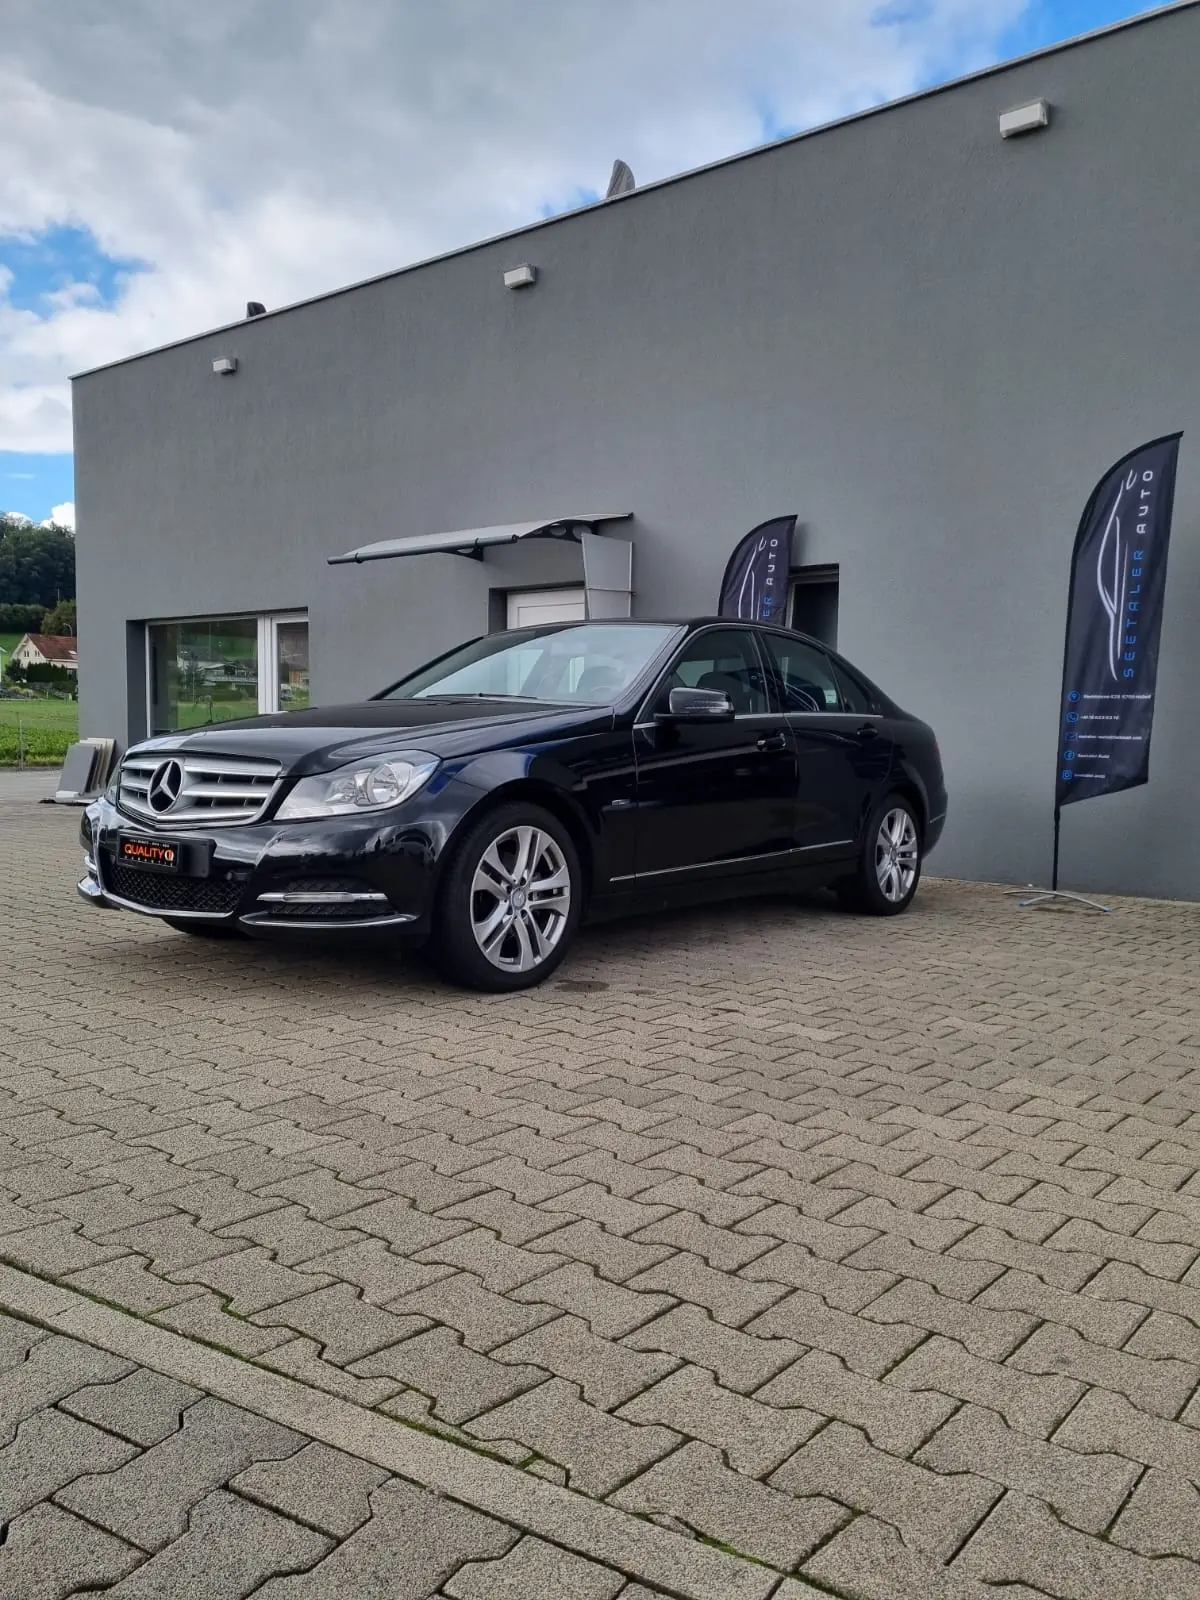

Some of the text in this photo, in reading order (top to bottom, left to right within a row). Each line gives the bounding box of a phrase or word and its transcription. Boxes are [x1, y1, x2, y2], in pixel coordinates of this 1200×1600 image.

[766, 539, 778, 586] AUTO
[1123, 470, 1154, 678] SEETALER AUTO
